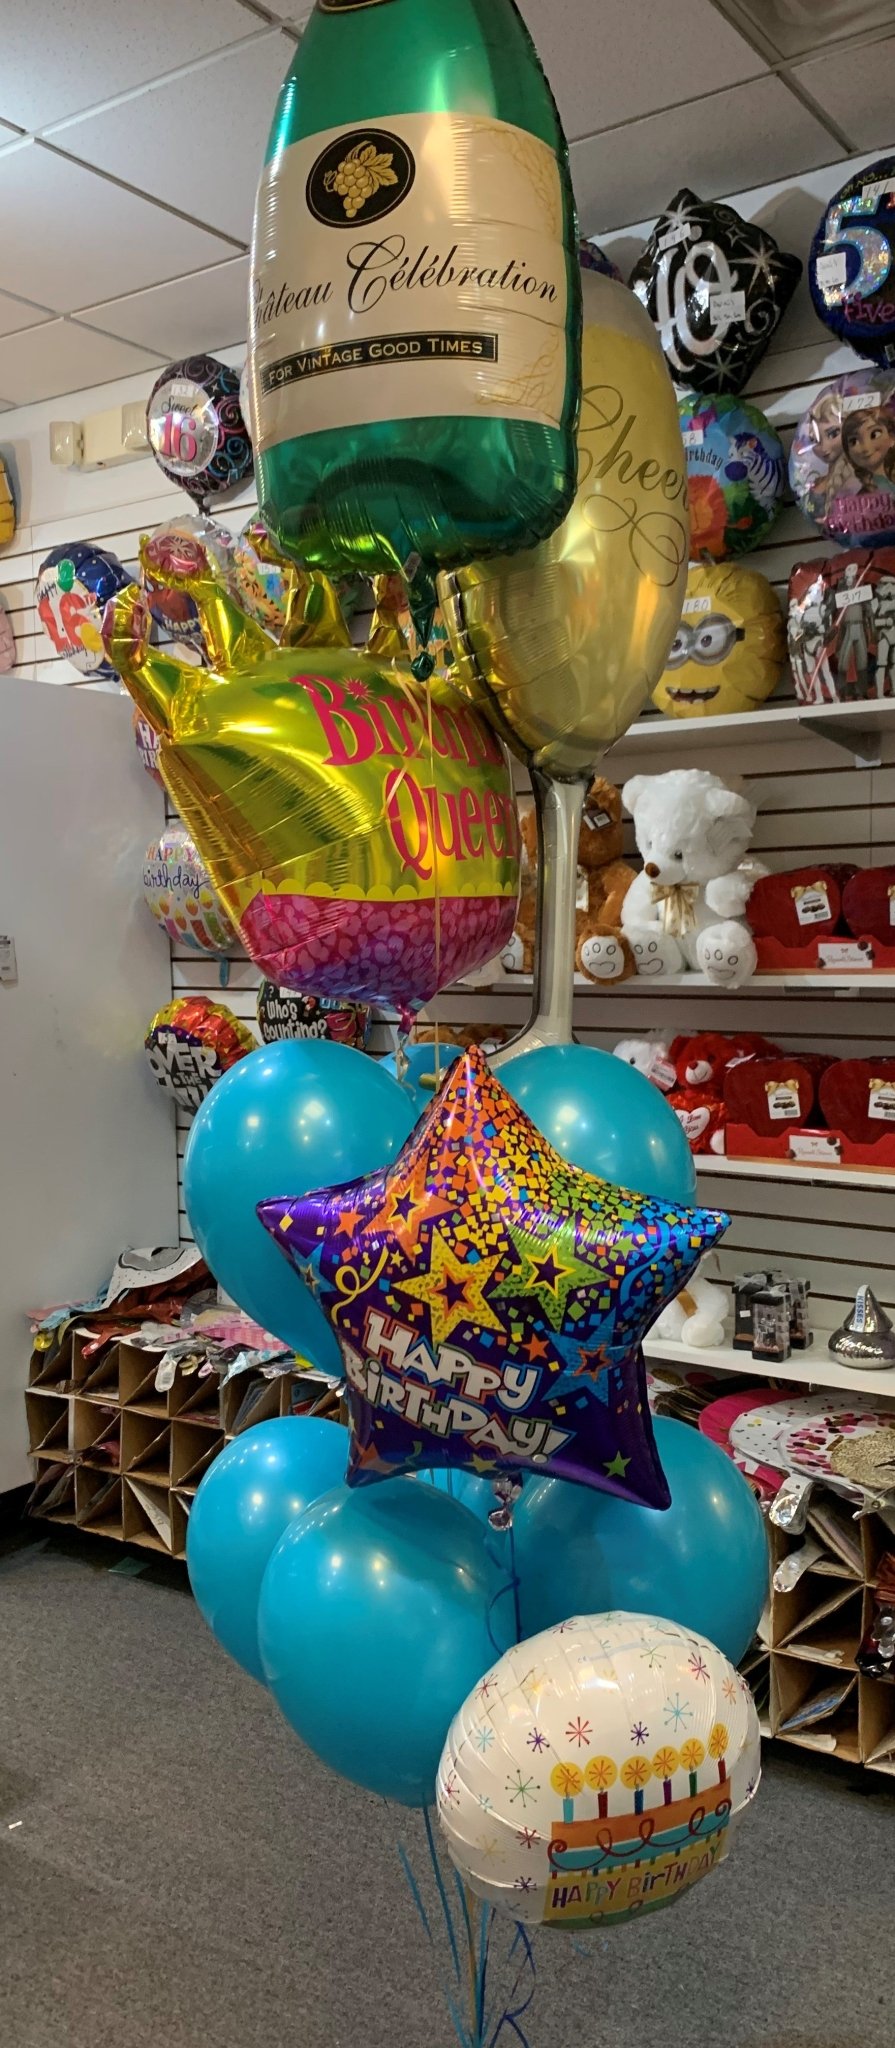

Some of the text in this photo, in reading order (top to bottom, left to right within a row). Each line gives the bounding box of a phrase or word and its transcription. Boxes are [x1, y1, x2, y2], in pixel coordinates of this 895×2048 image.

[252, 234, 558, 329] hâteau Célébration
[268, 337, 483, 385] FOR VINTAGE GOOD TIMES
[159, 413, 197, 462] 16
[684, 446, 724, 471] irthday
[38, 592, 91, 652] 16
[146, 847, 194, 862] HAPPY
[143, 865, 209, 899] birthday
[266, 999, 298, 1020] Who's
[145, 1041, 222, 1080] OVER
[856, 1295, 864, 1324] KISSES
[362, 1306, 543, 1412] HAPPY
[552, 1878, 621, 1908] HAPPY
